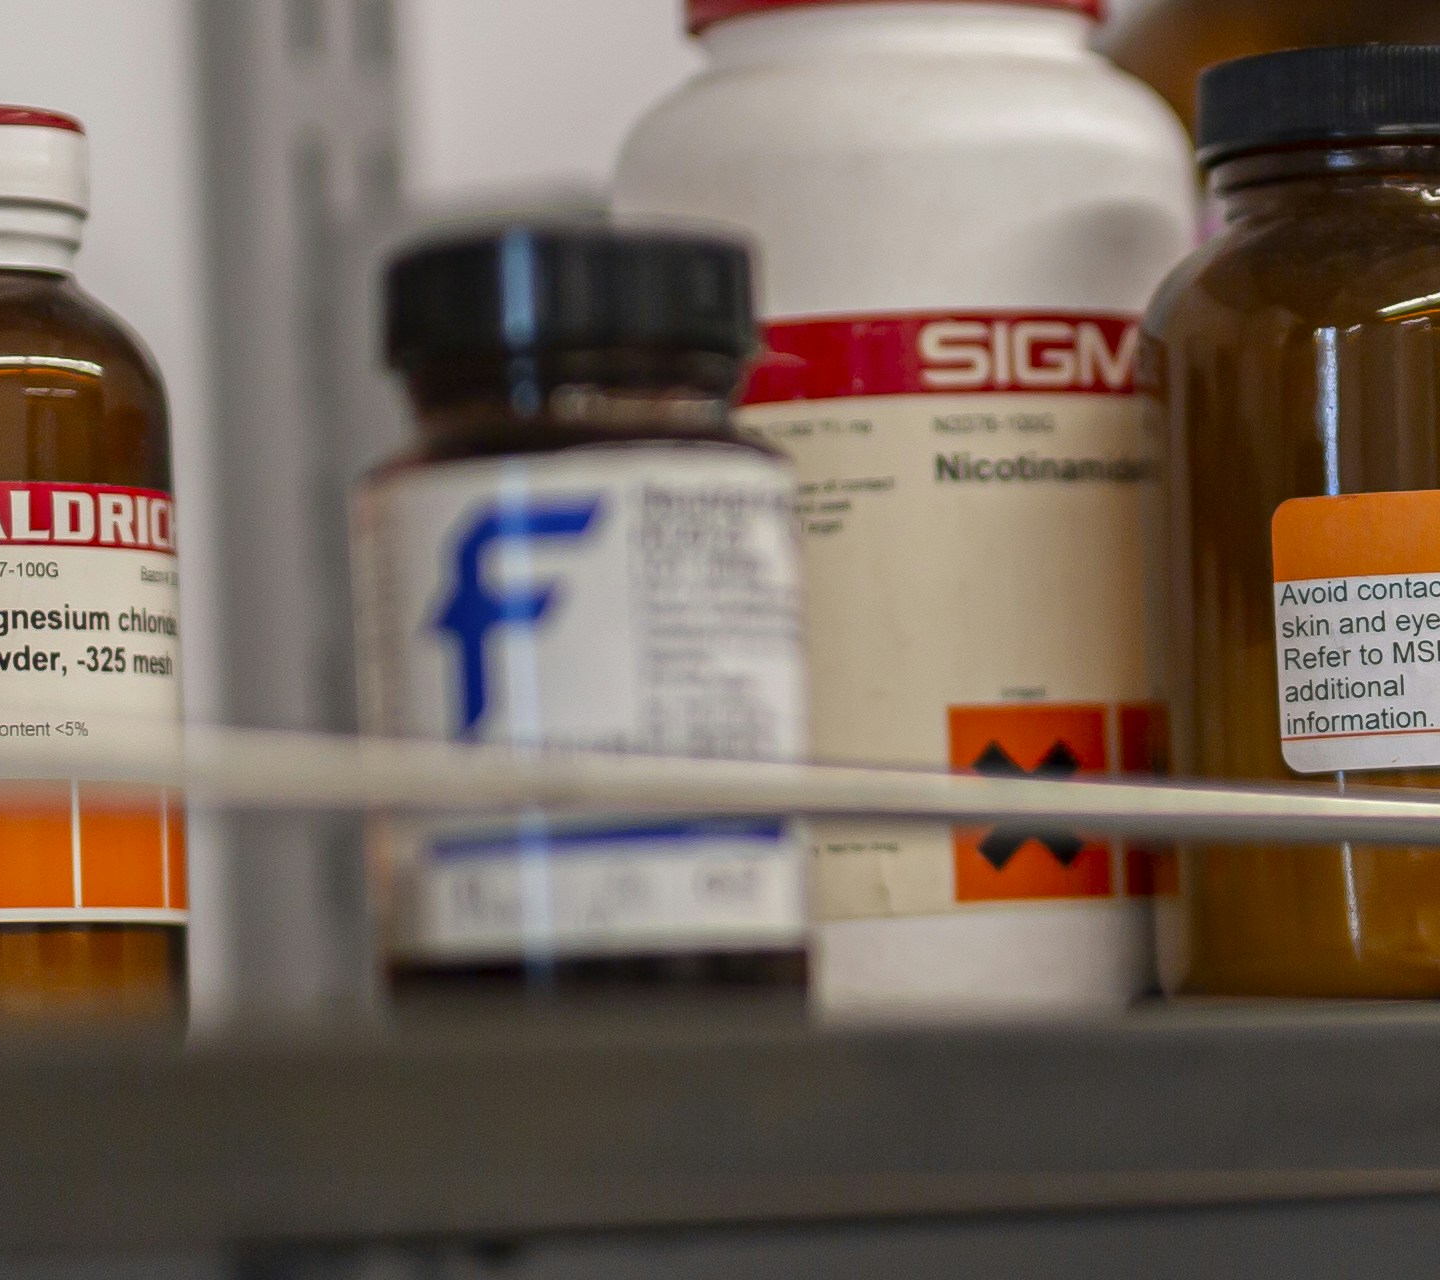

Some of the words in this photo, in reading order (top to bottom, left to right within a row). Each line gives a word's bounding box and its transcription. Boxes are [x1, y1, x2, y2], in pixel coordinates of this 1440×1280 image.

[917, 320, 1138, 389] SIGM
[1280, 579, 1348, 606] Avoid
[1281, 614, 1330, 638] skin
[1338, 610, 1386, 635] and
[77, 645, 126, 673] -325
[133, 650, 173, 676] mesh
[1284, 645, 1351, 671] Refer
[1359, 643, 1383, 666] to
[1284, 674, 1405, 704] additional
[55, 721, 88, 737] <5%
[1286, 706, 1435, 735] information.
